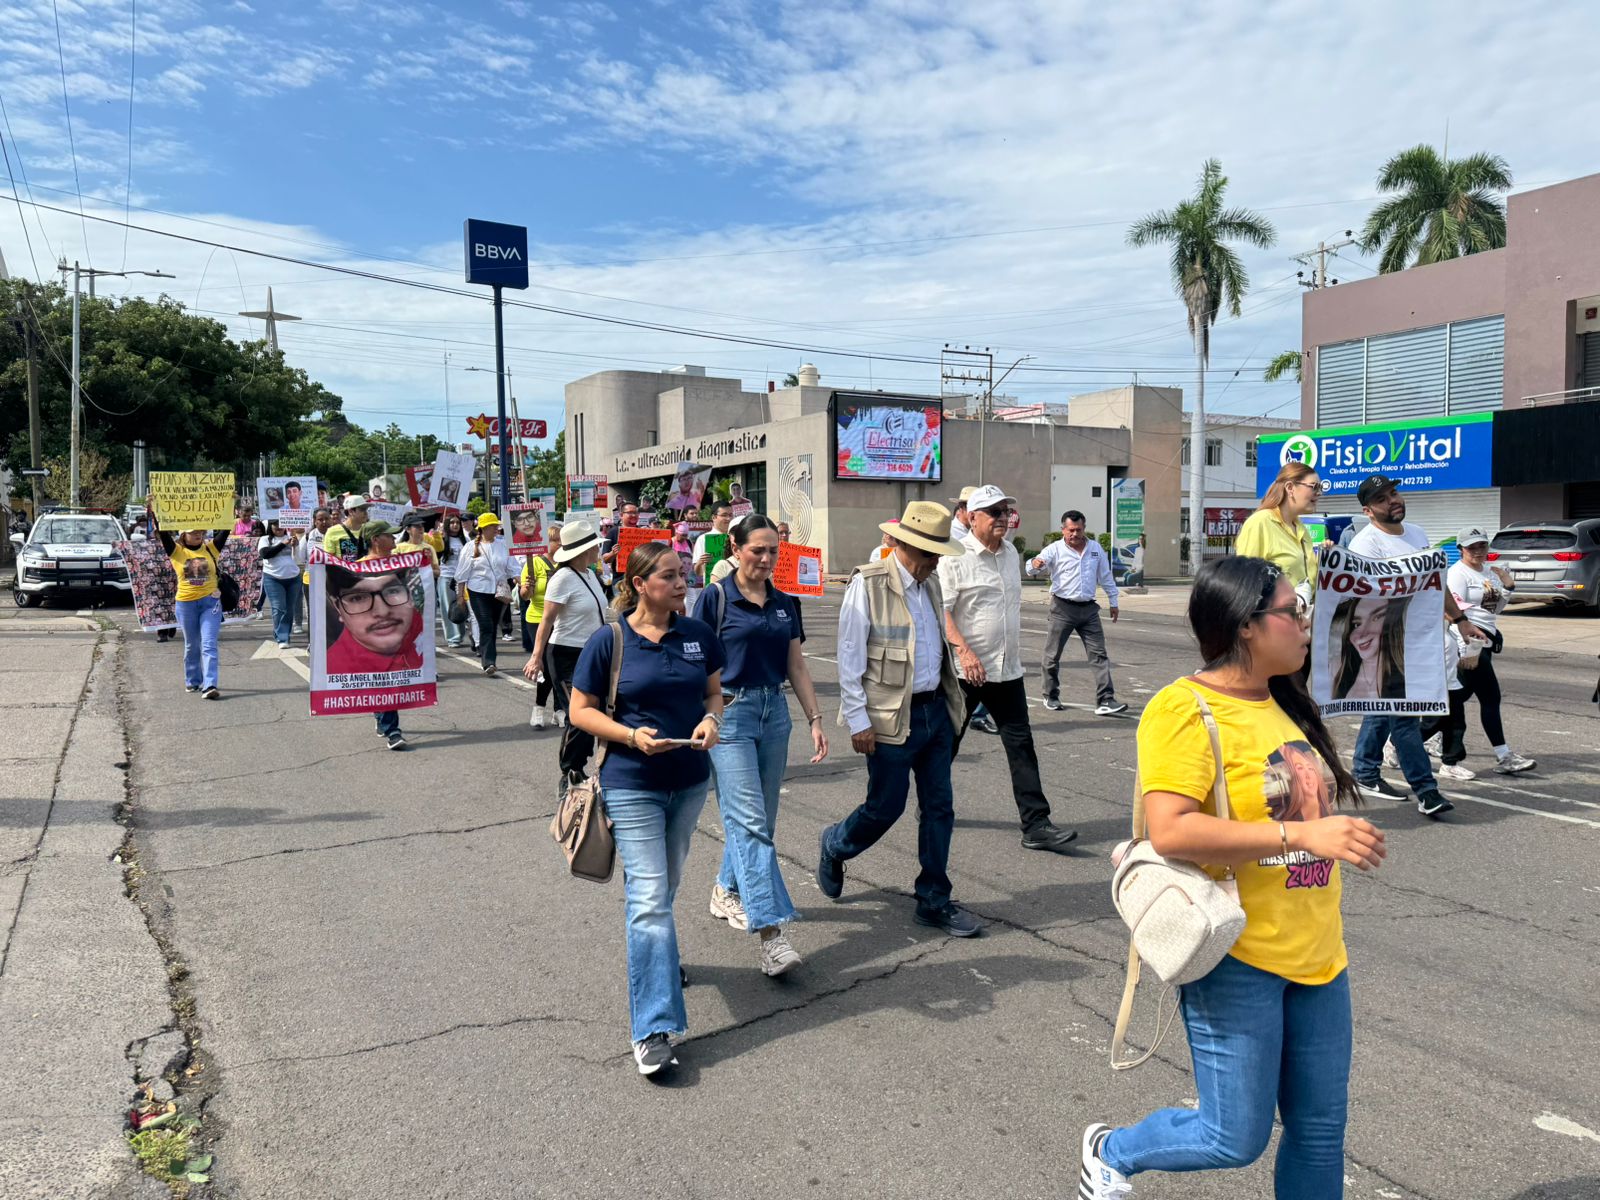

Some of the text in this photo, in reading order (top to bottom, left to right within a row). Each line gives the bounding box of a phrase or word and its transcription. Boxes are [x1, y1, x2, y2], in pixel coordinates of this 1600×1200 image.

[475, 242, 522, 261] BBVA
[524, 421, 542, 437] Jr.
[866, 430, 915, 448] Electrisa
[1320, 427, 1462, 468] FisioVital
[637, 444, 692, 469] ultrasonido
[183, 473, 198, 485] SIN
[1359, 466, 1380, 474] Terapia
[1348, 480, 1358, 489] 257
[1404, 476, 1415, 485] 472
[1415, 476, 1424, 484] 72
[1424, 475, 1433, 484] 93
[1220, 509, 1234, 522] SE
[312, 549, 423, 573] DESAPARECIDO
[1320, 549, 1341, 569] NO
[1400, 550, 1447, 574] TODOS
[1317, 570, 1443, 597] NOS FALTA
[372, 671, 391, 681] NAVA
[323, 690, 426, 709] #HASTAENCONTRARTE
[1342, 701, 1392, 712] BERRELLEZA
[1285, 858, 1335, 889] ZURY
